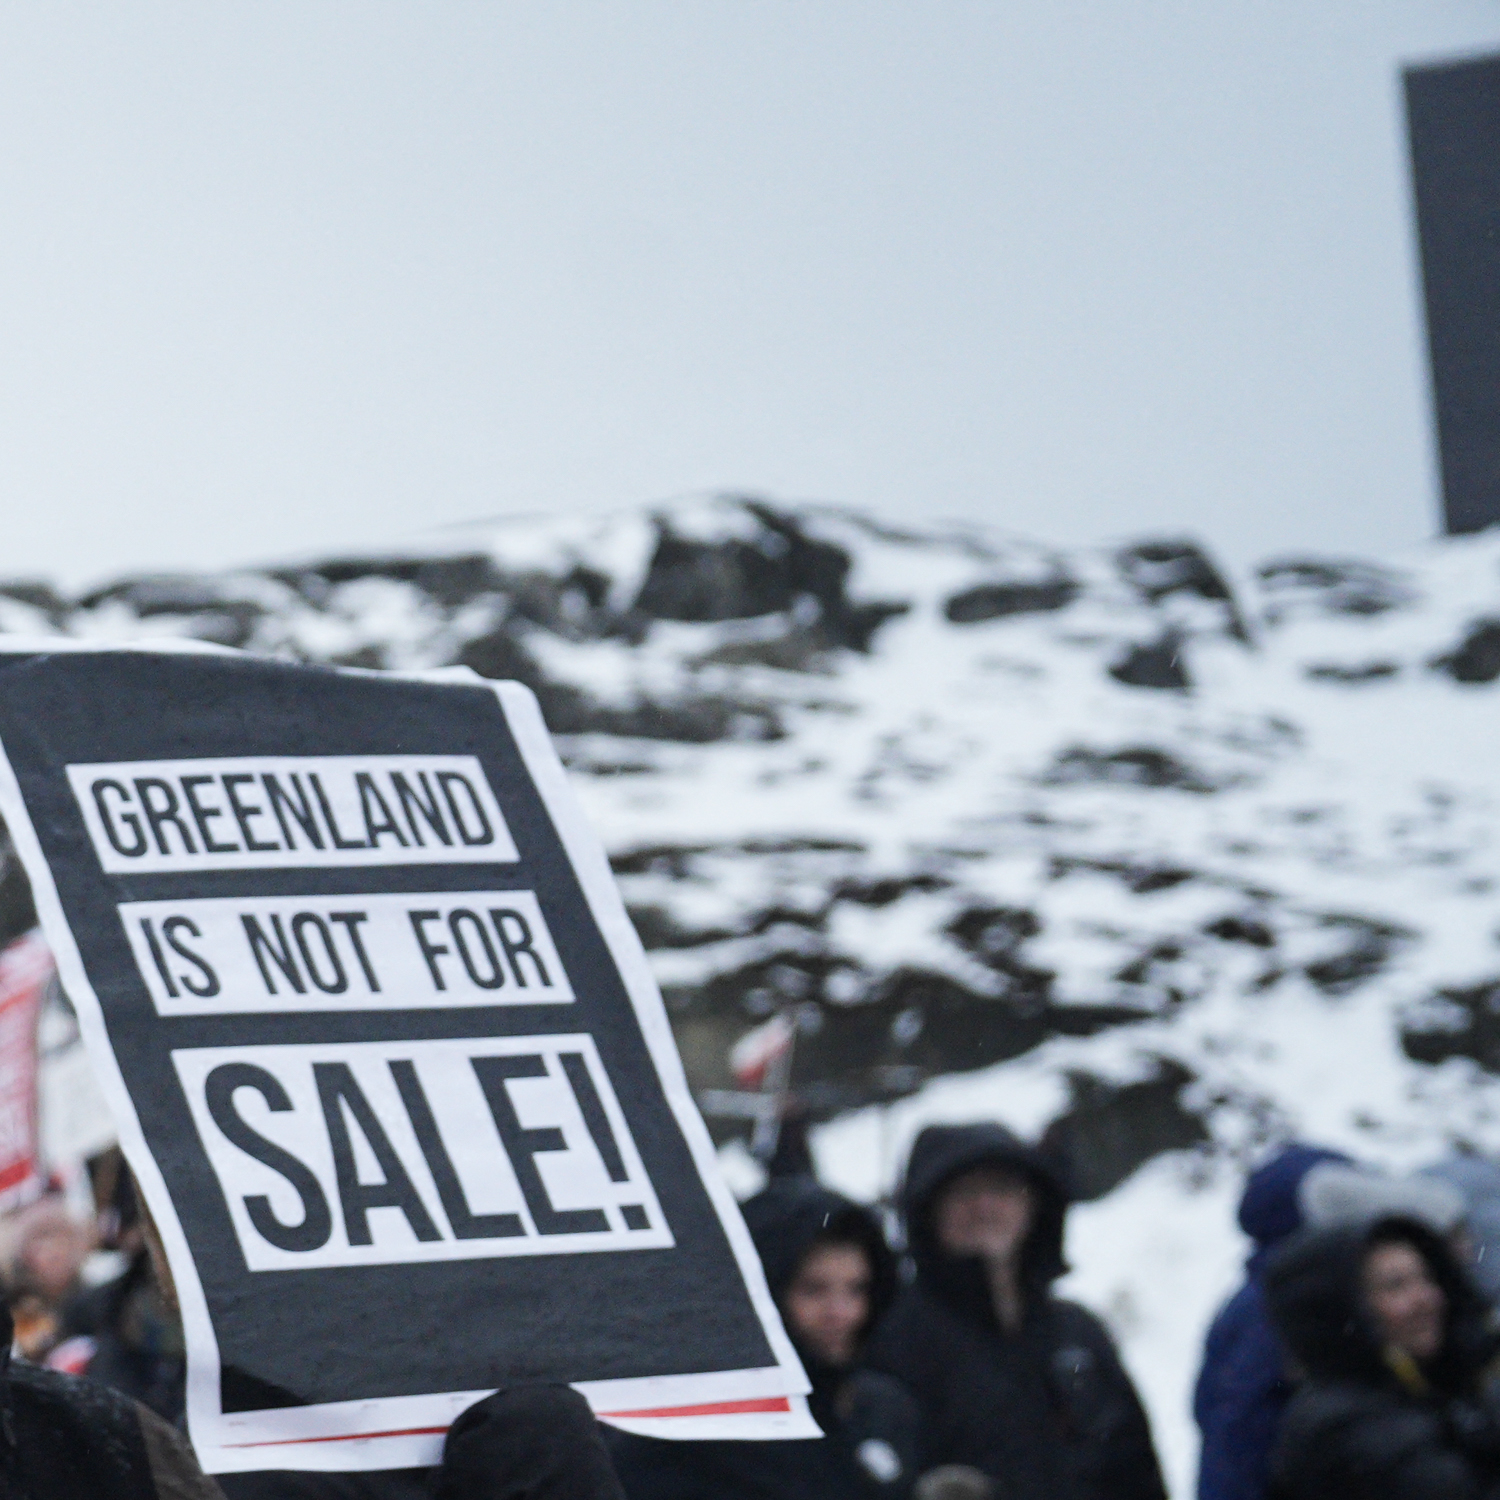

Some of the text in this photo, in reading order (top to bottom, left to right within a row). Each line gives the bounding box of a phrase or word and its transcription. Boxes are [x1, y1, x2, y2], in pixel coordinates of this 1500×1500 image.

[90, 770, 496, 858] GREENLAND
[138, 907, 555, 999] IS NOT FOR
[203, 1053, 652, 1252] SALE!
